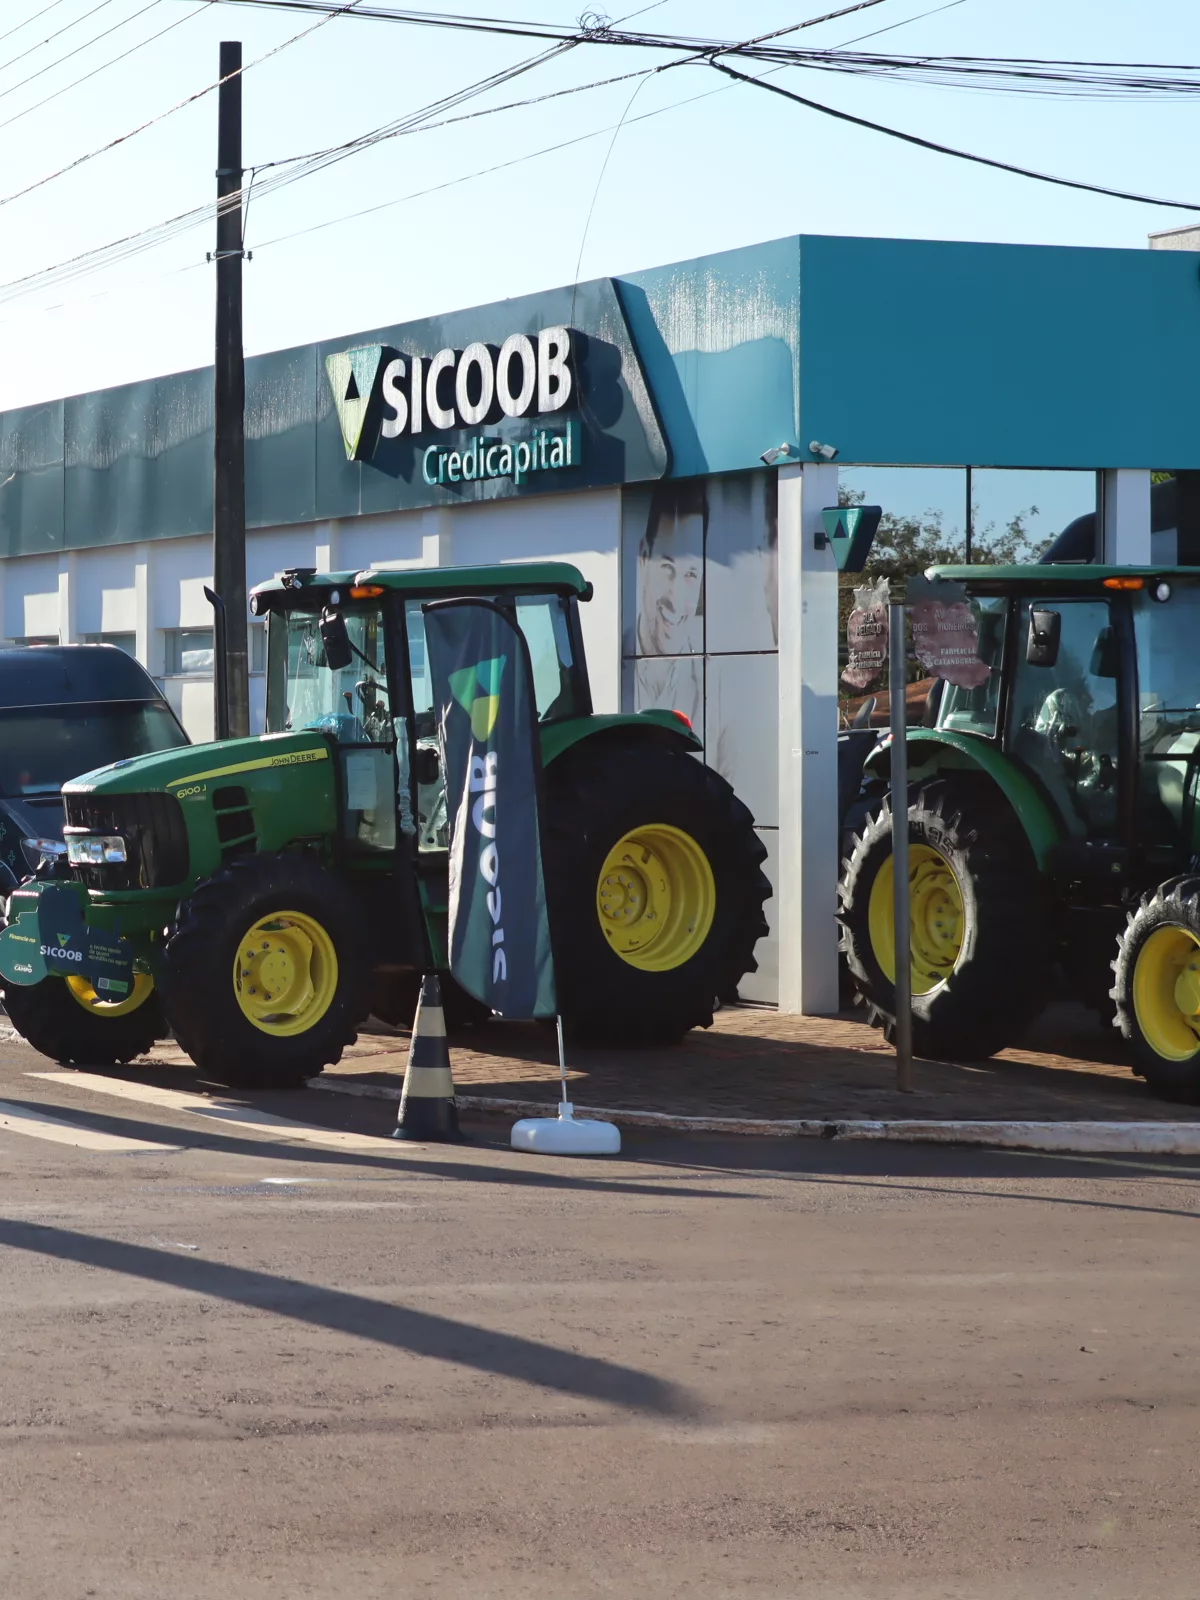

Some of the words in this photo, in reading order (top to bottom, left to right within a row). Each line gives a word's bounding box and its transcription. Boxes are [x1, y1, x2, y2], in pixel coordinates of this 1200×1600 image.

[381, 326, 574, 438] SICOOB
[421, 421, 574, 486] Credicapital
[912, 623, 928, 632] DOS
[270, 757, 290, 768] JOHN
[290, 753, 317, 763] DEERE
[176, 787, 201, 799] 6100
[202, 784, 207, 792] J
[8, 932, 29, 942] Financie
[39, 945, 83, 961] SICOOB
[13, 965, 33, 973] CAMPO
